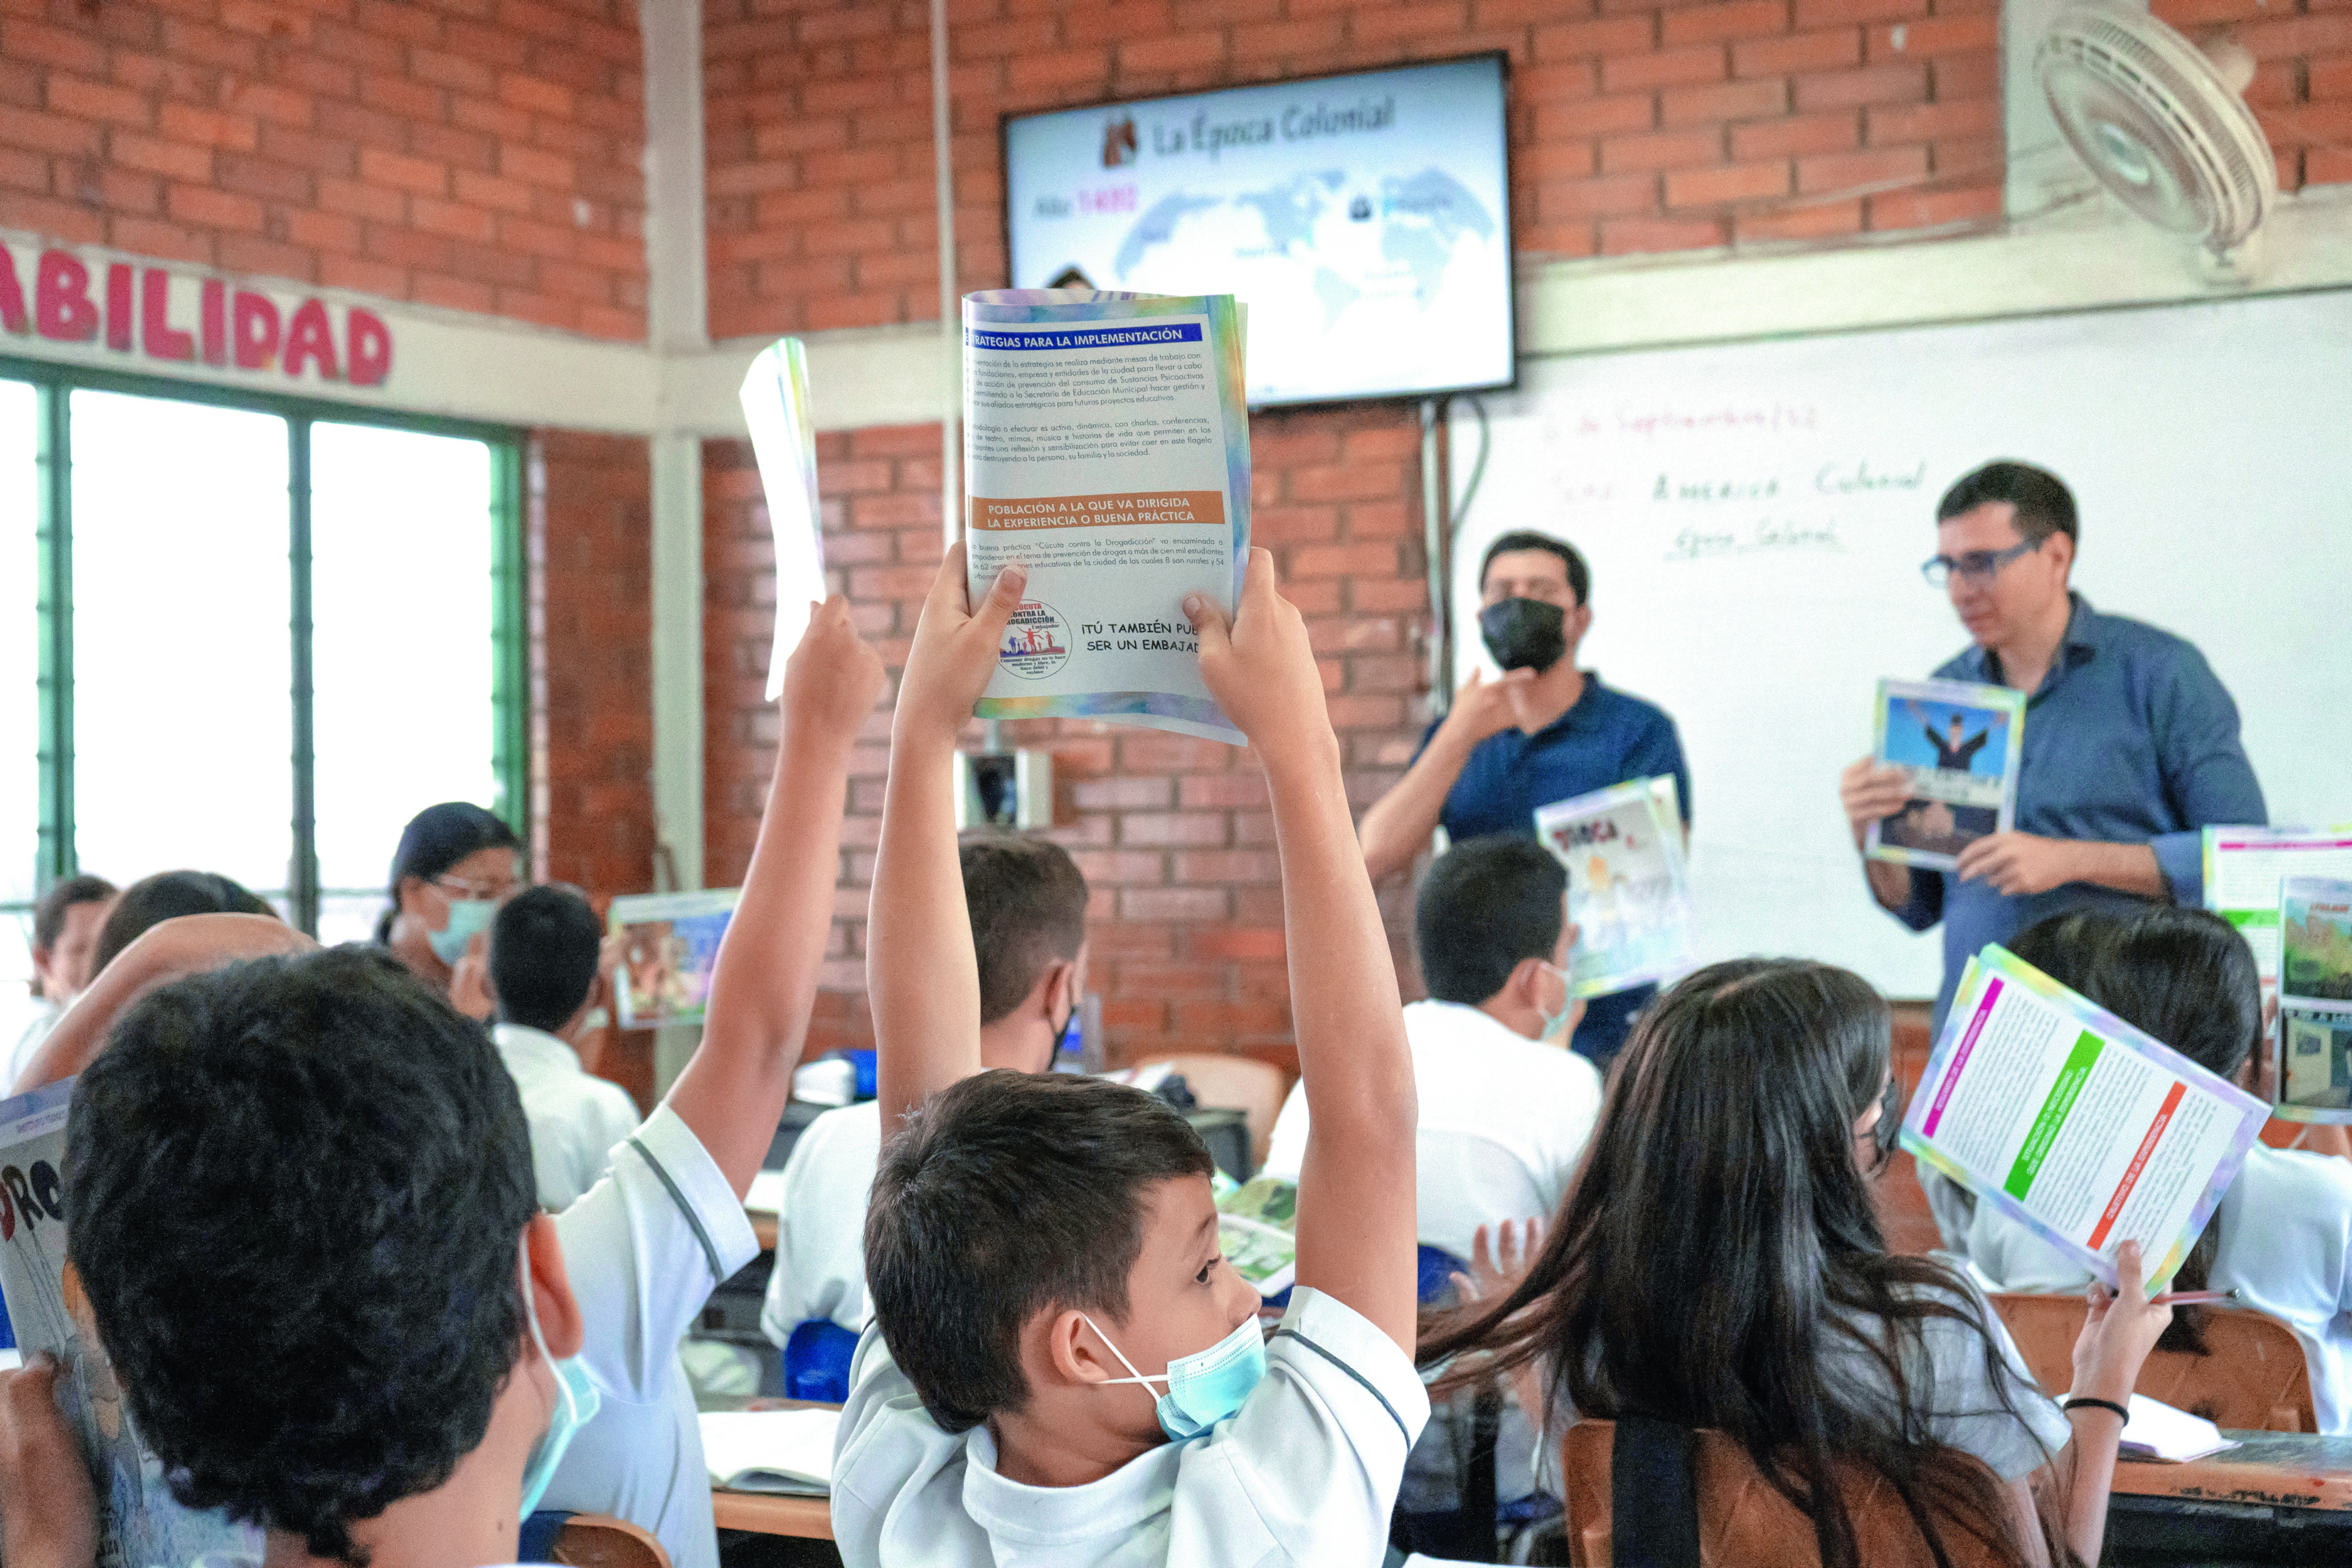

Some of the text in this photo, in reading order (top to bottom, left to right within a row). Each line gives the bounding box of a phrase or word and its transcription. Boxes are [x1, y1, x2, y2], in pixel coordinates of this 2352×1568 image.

[1154, 122, 1188, 156] La
[1281, 95, 1395, 142] Colonial
[965, 327, 1183, 348] TRATEGIAS PARA LA IMPLEMENTACIÓN
[1020, 360, 1054, 368] estrategia
[1055, 368, 1089, 377] entidades
[1110, 366, 1135, 374] ciudad
[1018, 380, 1055, 389] prevención
[1161, 373, 1203, 381] Psicoactivas
[1112, 385, 1148, 394] Municipal
[1173, 383, 1199, 392] gestión
[1015, 400, 1055, 409] estratégicos
[1048, 442, 1099, 451] sensibilización
[1101, 441, 1118, 449] para
[1188, 437, 1213, 445] flagelo
[983, 454, 1021, 464] destruyendo
[988, 497, 1191, 515] POBLACIÓN A LA QUE VA DIRIGIDA
[987, 509, 1196, 528] LA EXPERIENCIA O BUENA PRÁCTICA
[1003, 543, 1031, 552] práctica
[1053, 550, 1090, 559] prevención
[1102, 548, 1127, 557] drogas
[1007, 616, 1054, 625] OGADICCIÓN
[1108, 619, 1171, 634] TAMBIÉN
[1176, 624, 1198, 635] PUE
[1087, 640, 1198, 653] SER UN EMBAJA
